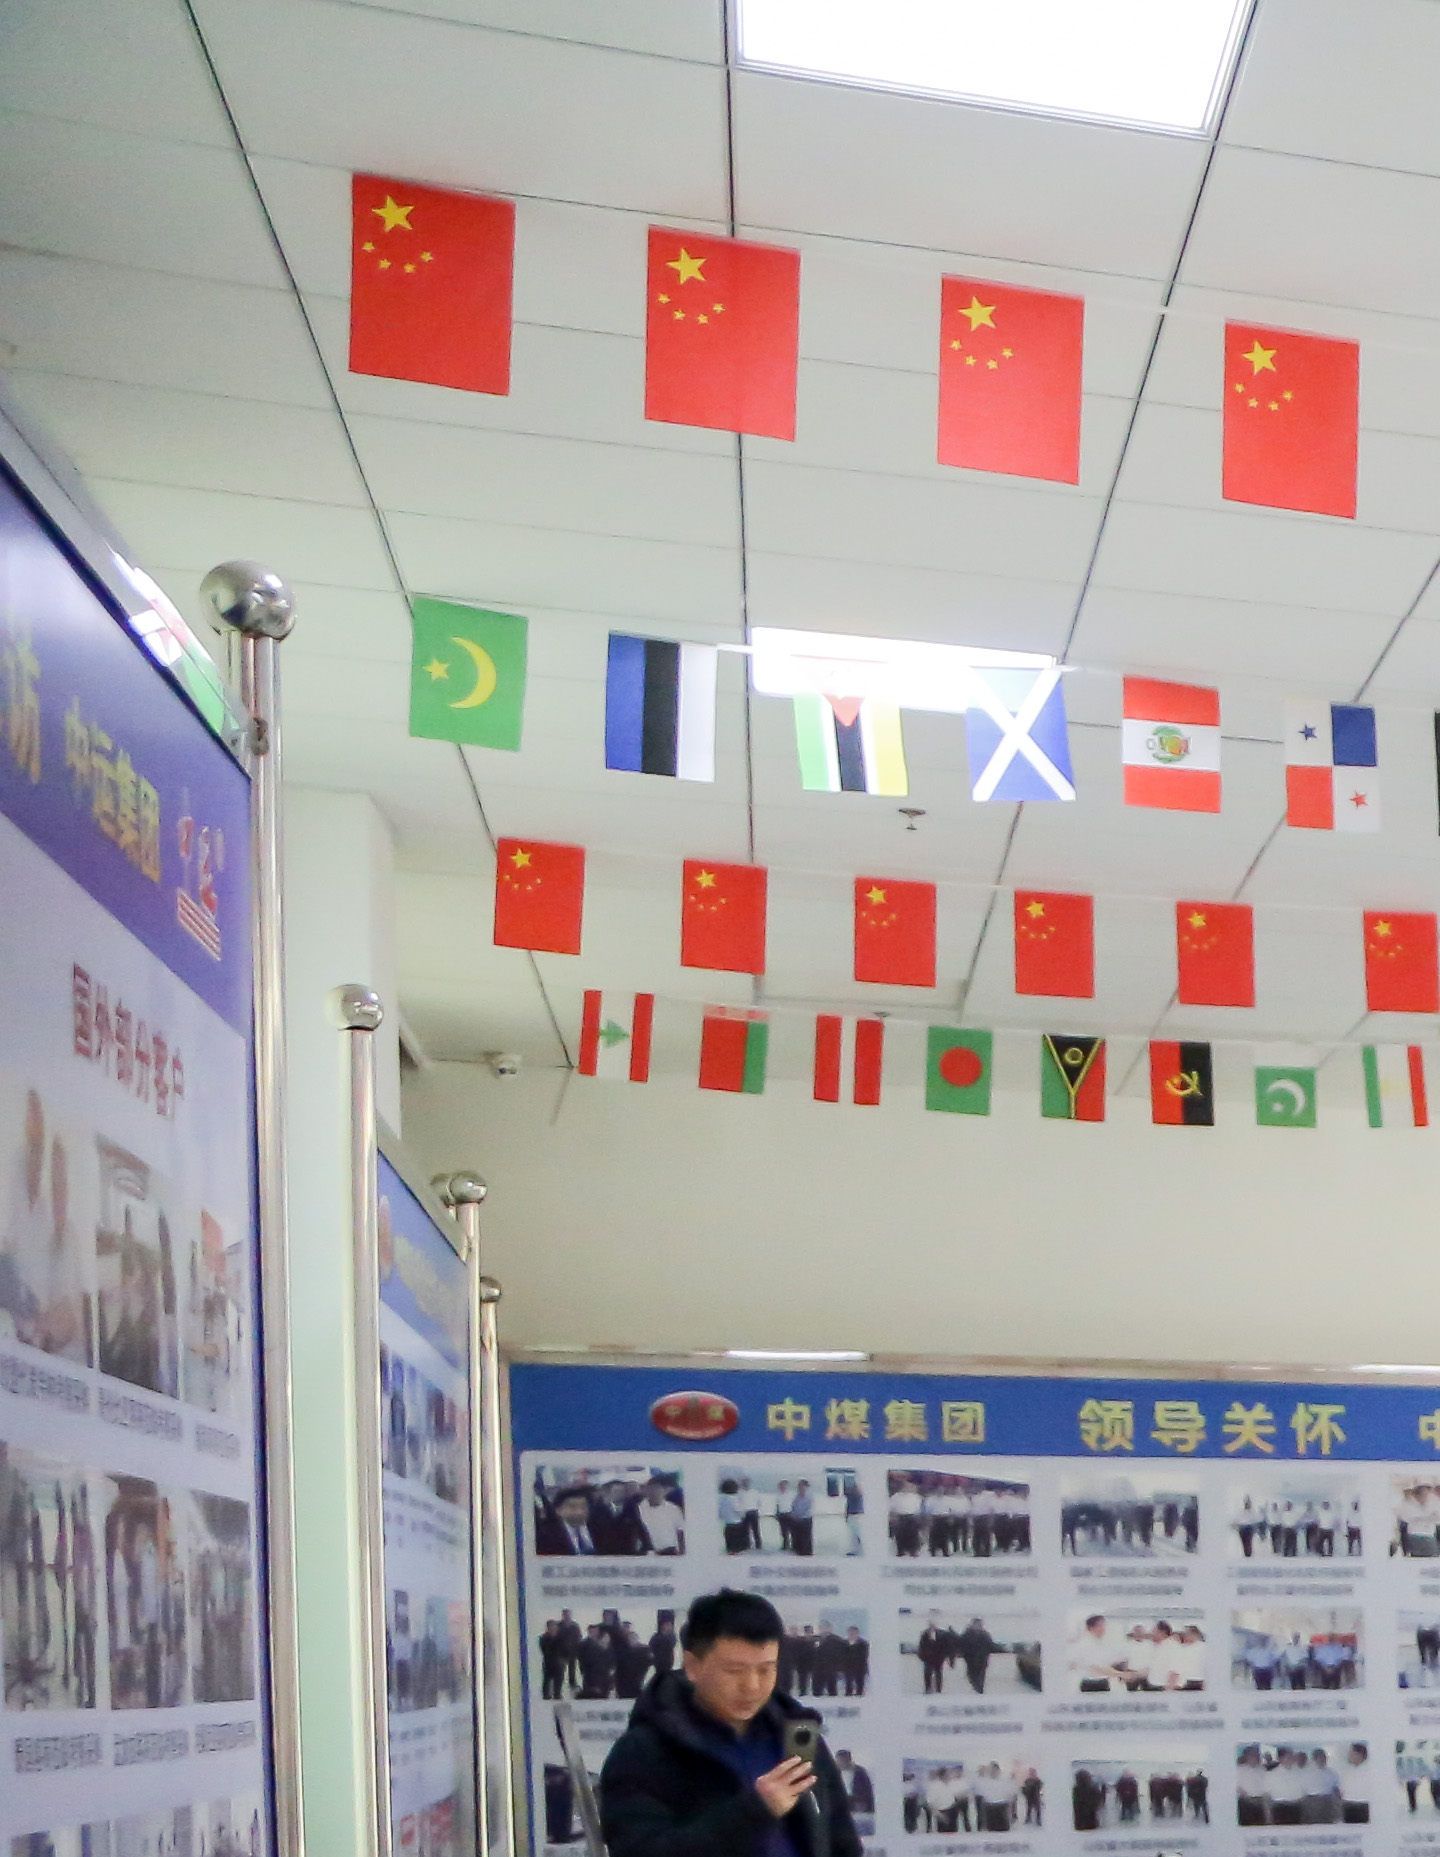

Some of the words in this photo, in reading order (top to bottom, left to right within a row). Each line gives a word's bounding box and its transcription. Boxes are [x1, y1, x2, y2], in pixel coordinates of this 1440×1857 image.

[767, 1399, 986, 1443] 中煤集团
[1078, 1399, 1347, 1455] 领导关怀
